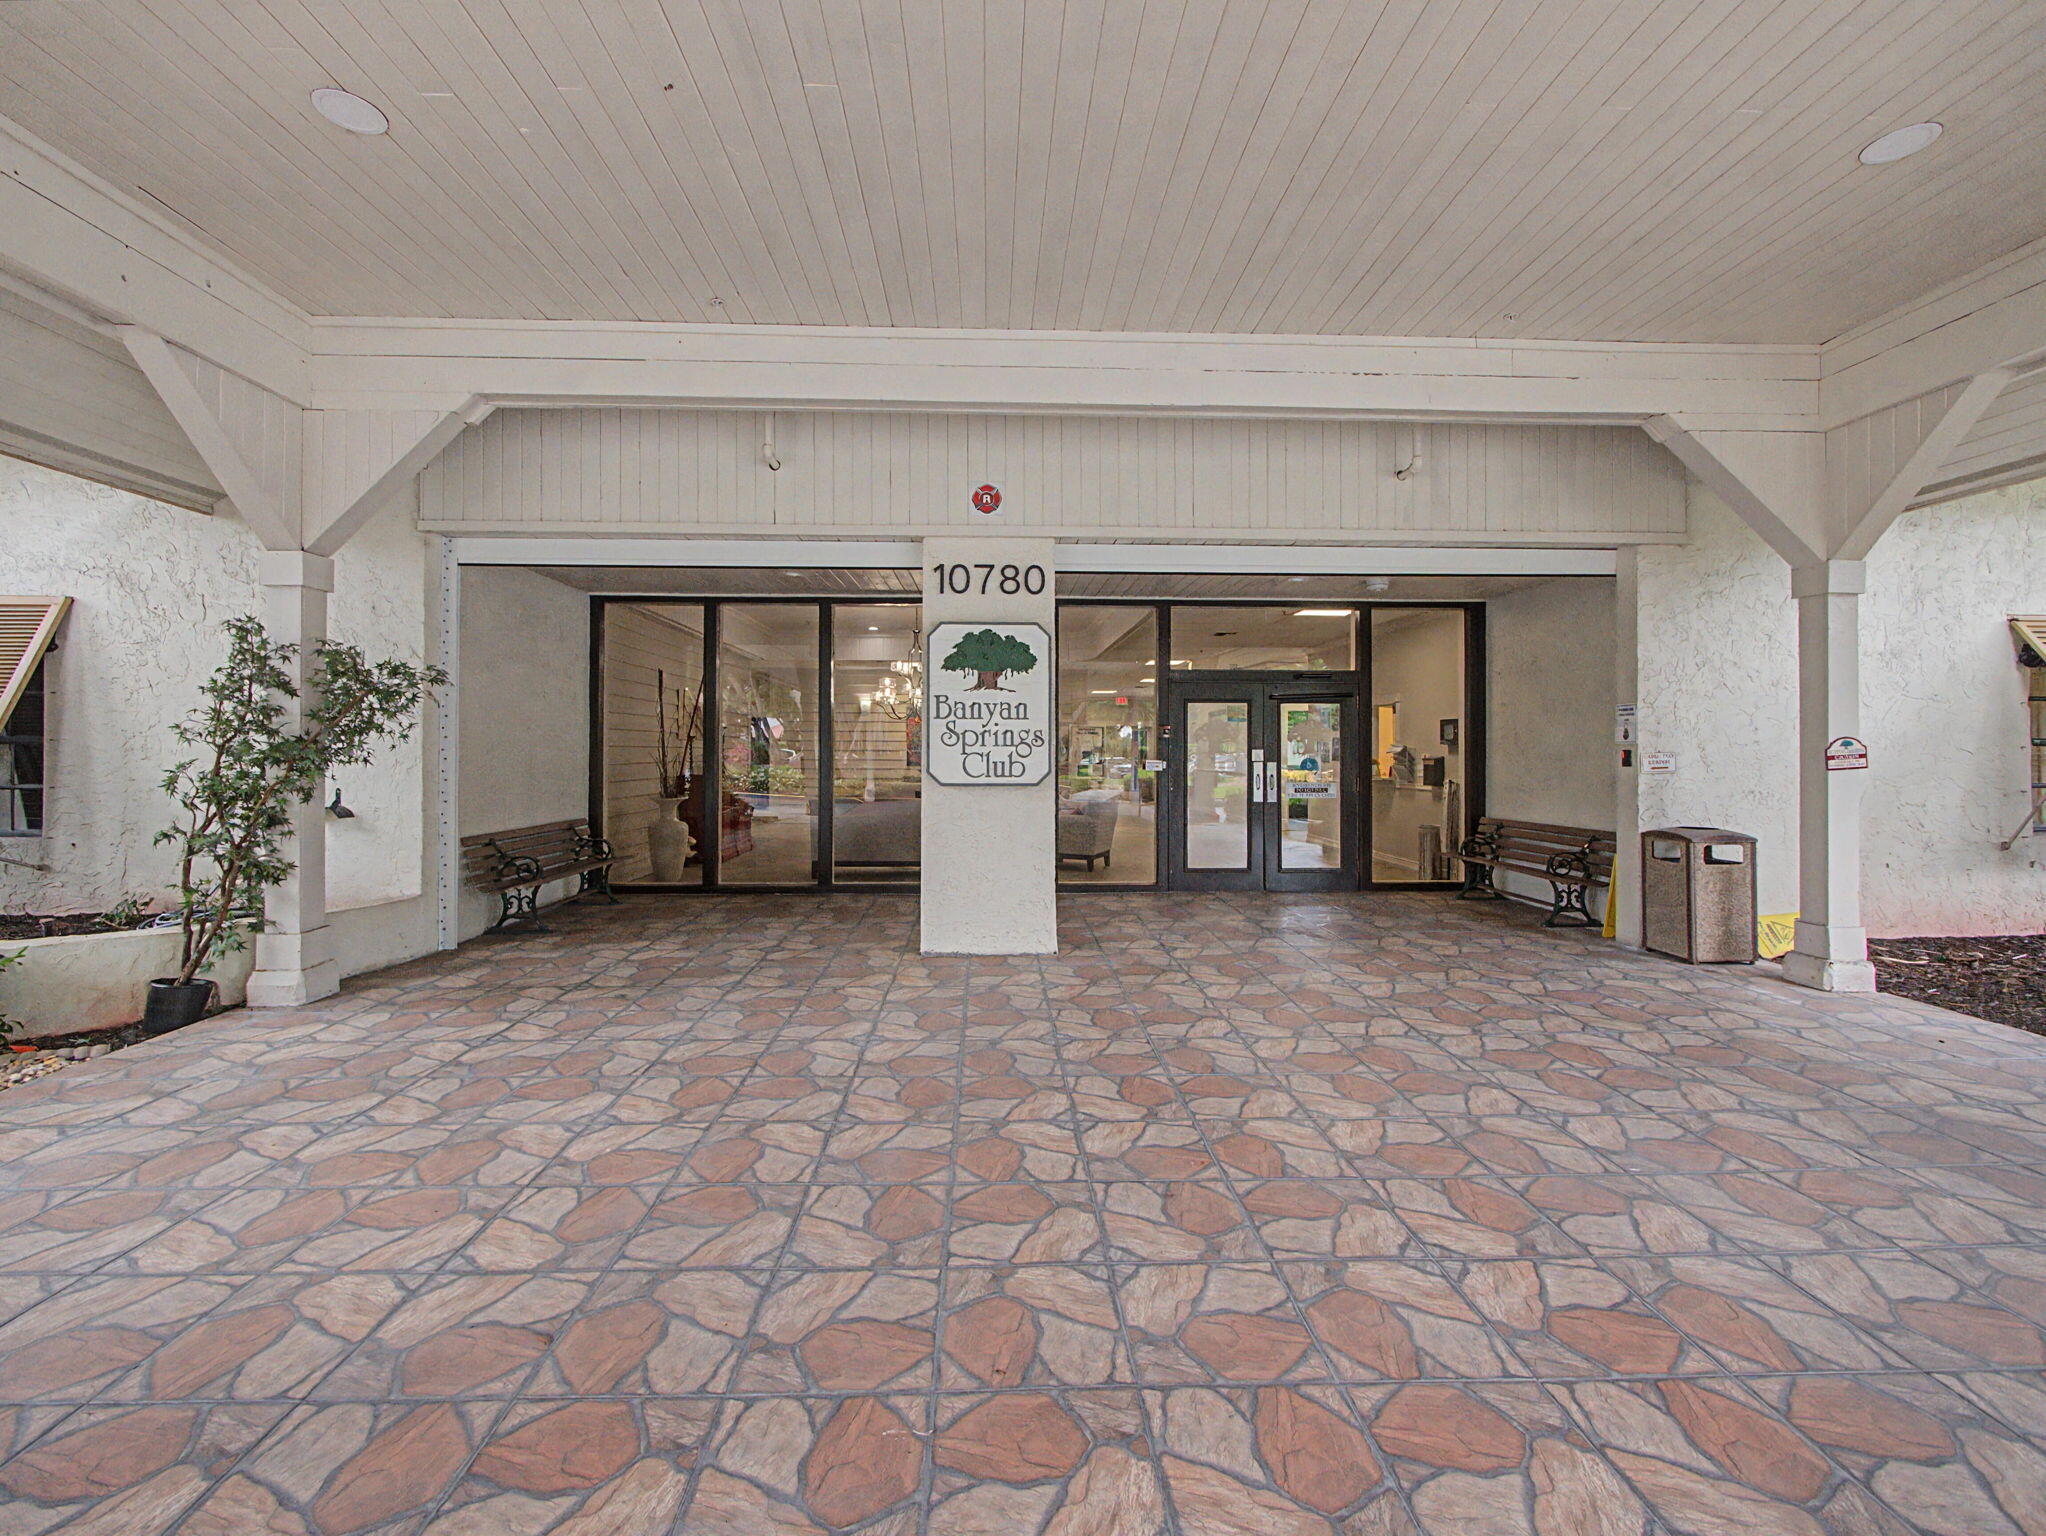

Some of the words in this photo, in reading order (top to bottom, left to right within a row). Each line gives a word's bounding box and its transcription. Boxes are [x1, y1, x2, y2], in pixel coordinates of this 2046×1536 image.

[933, 563, 1046, 596] 10780
[933, 694, 1030, 729] Banyan
[940, 719, 1046, 759] Springs
[962, 750, 1027, 779] Club
